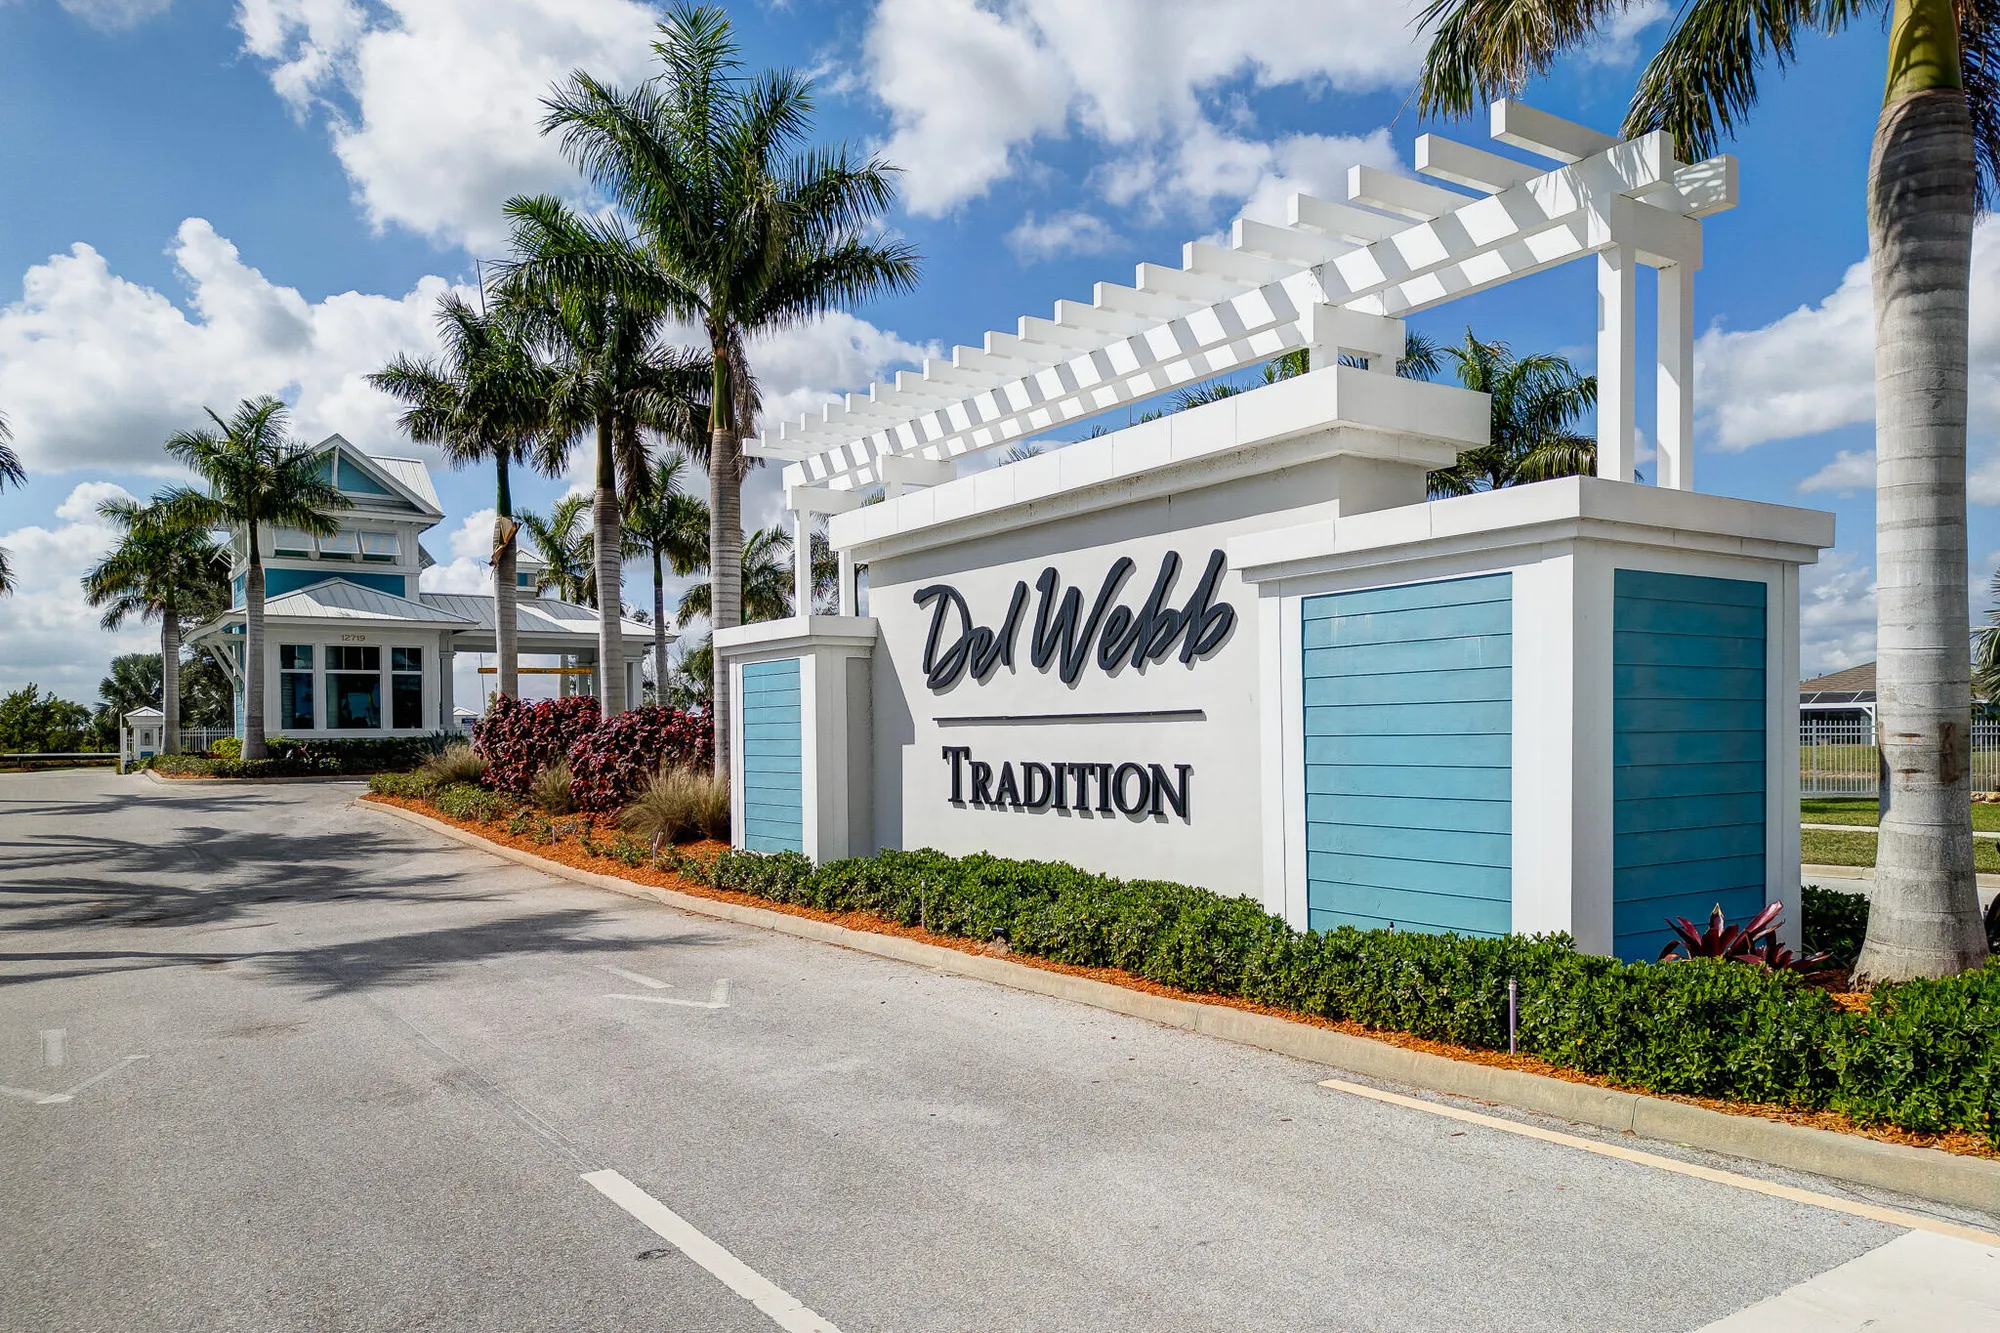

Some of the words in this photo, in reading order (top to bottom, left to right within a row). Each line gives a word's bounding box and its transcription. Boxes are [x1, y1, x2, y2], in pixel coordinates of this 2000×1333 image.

[341, 633, 366, 642] 12719
[913, 580, 1028, 690] Del
[1031, 548, 1235, 685] Webb
[941, 745, 1192, 819] TRADITION
